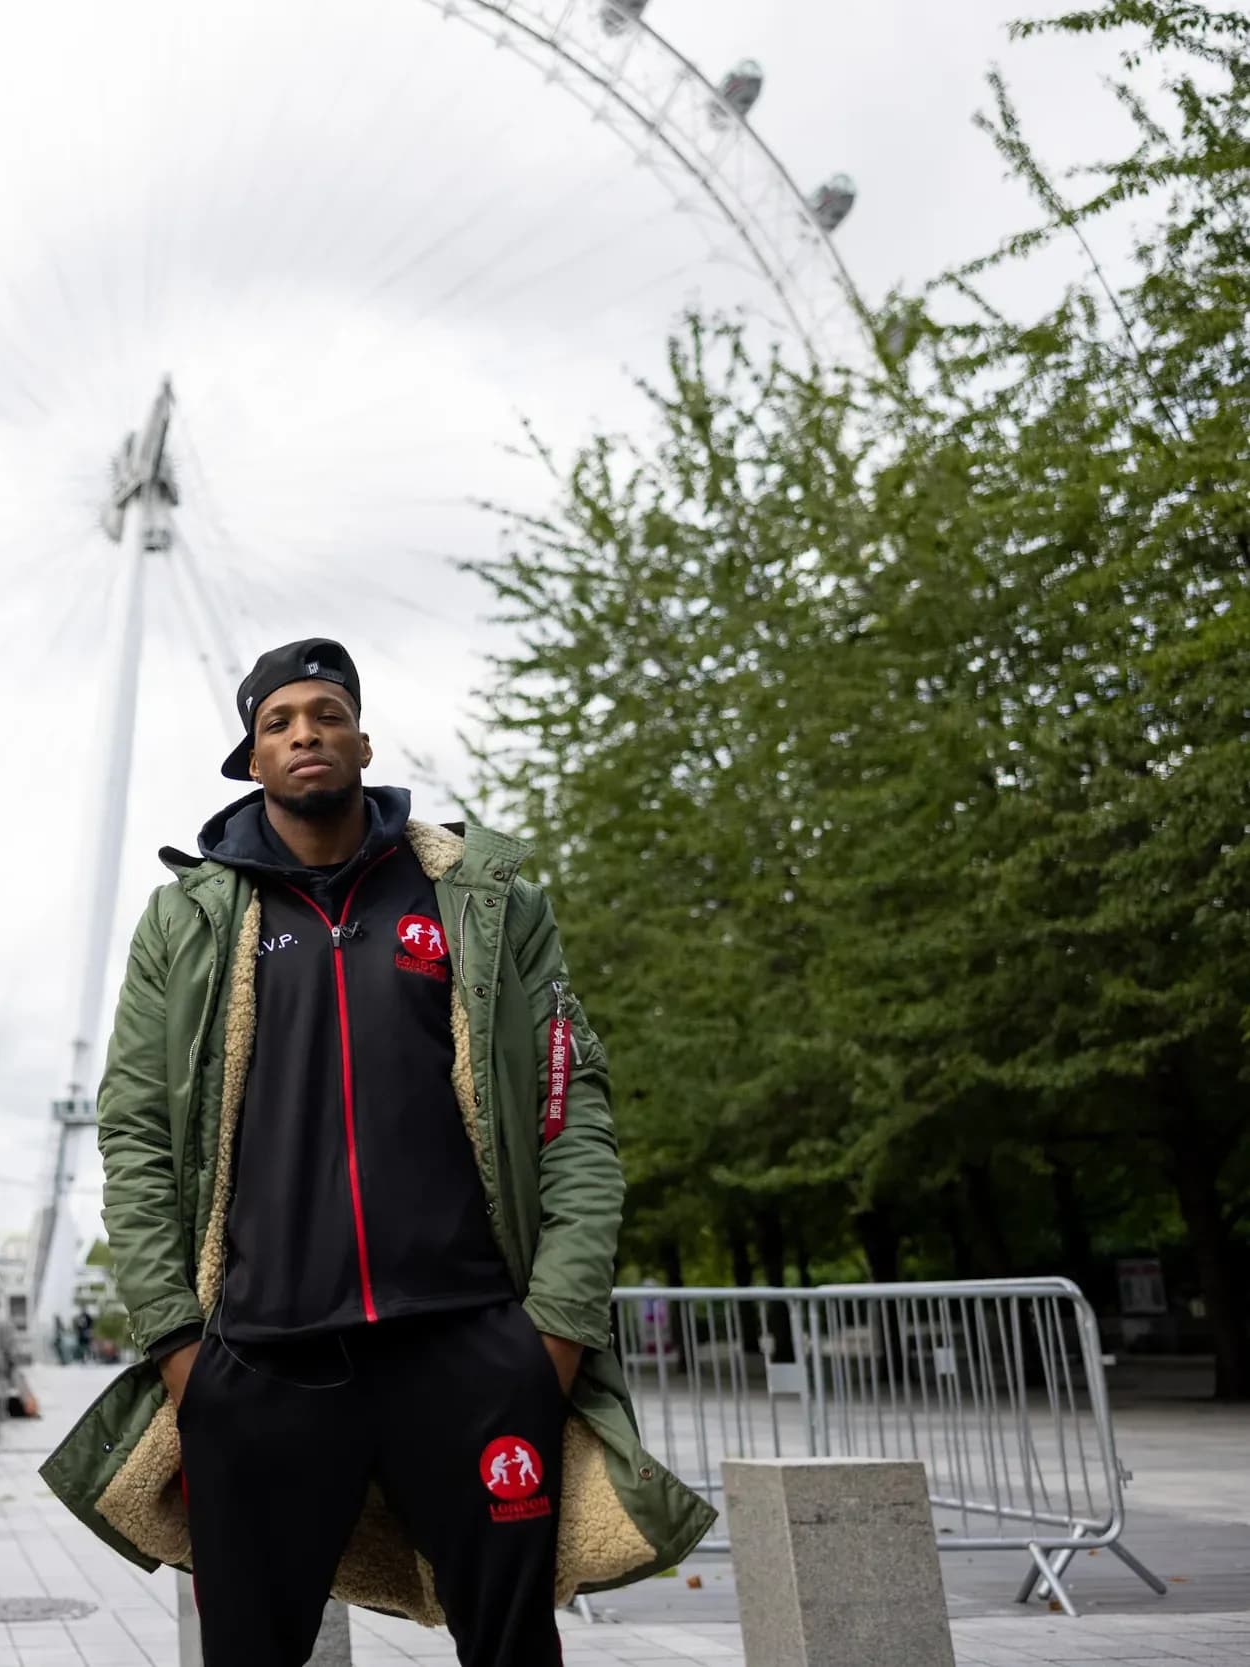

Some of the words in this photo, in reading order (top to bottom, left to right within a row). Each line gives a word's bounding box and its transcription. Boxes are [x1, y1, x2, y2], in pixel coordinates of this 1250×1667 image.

[552, 1045, 566, 1072] REMOVE
[552, 1072, 565, 1096] BEFORE
[549, 1099, 562, 1119] FLIGHT
